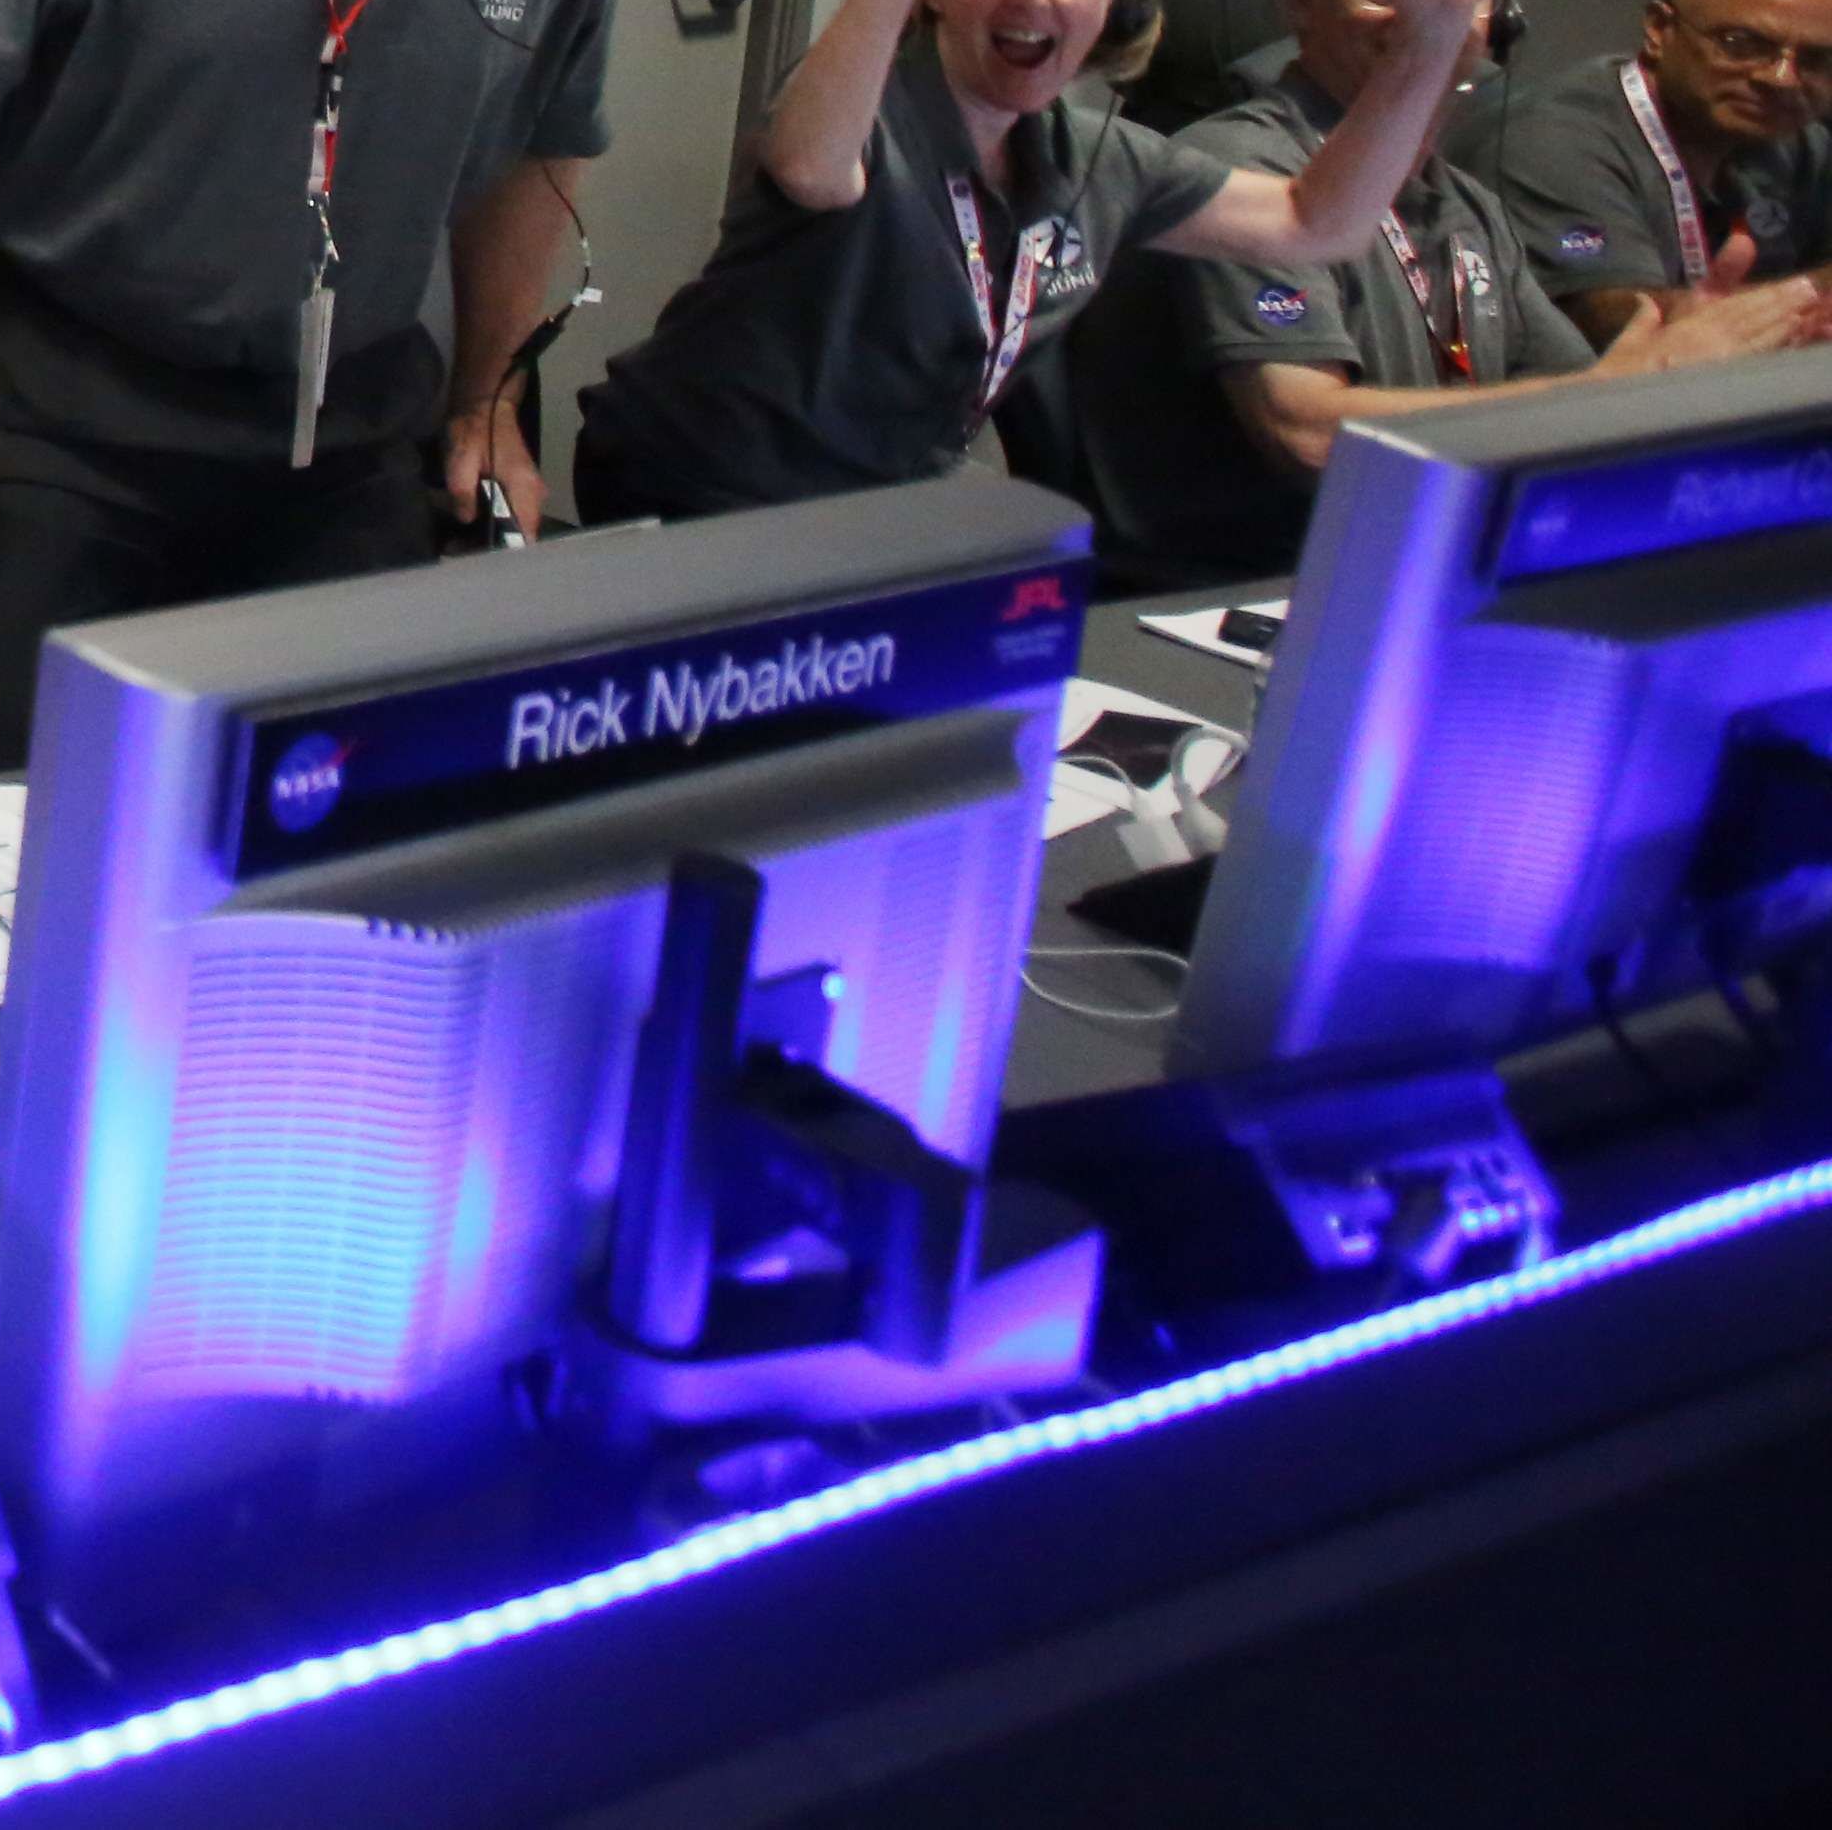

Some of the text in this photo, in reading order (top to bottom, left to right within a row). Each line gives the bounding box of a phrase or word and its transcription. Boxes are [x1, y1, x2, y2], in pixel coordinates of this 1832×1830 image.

[1257, 300, 1305, 312] NASA
[507, 633, 897, 770] Rick Nybakken
[276, 767, 340, 799] NASA
